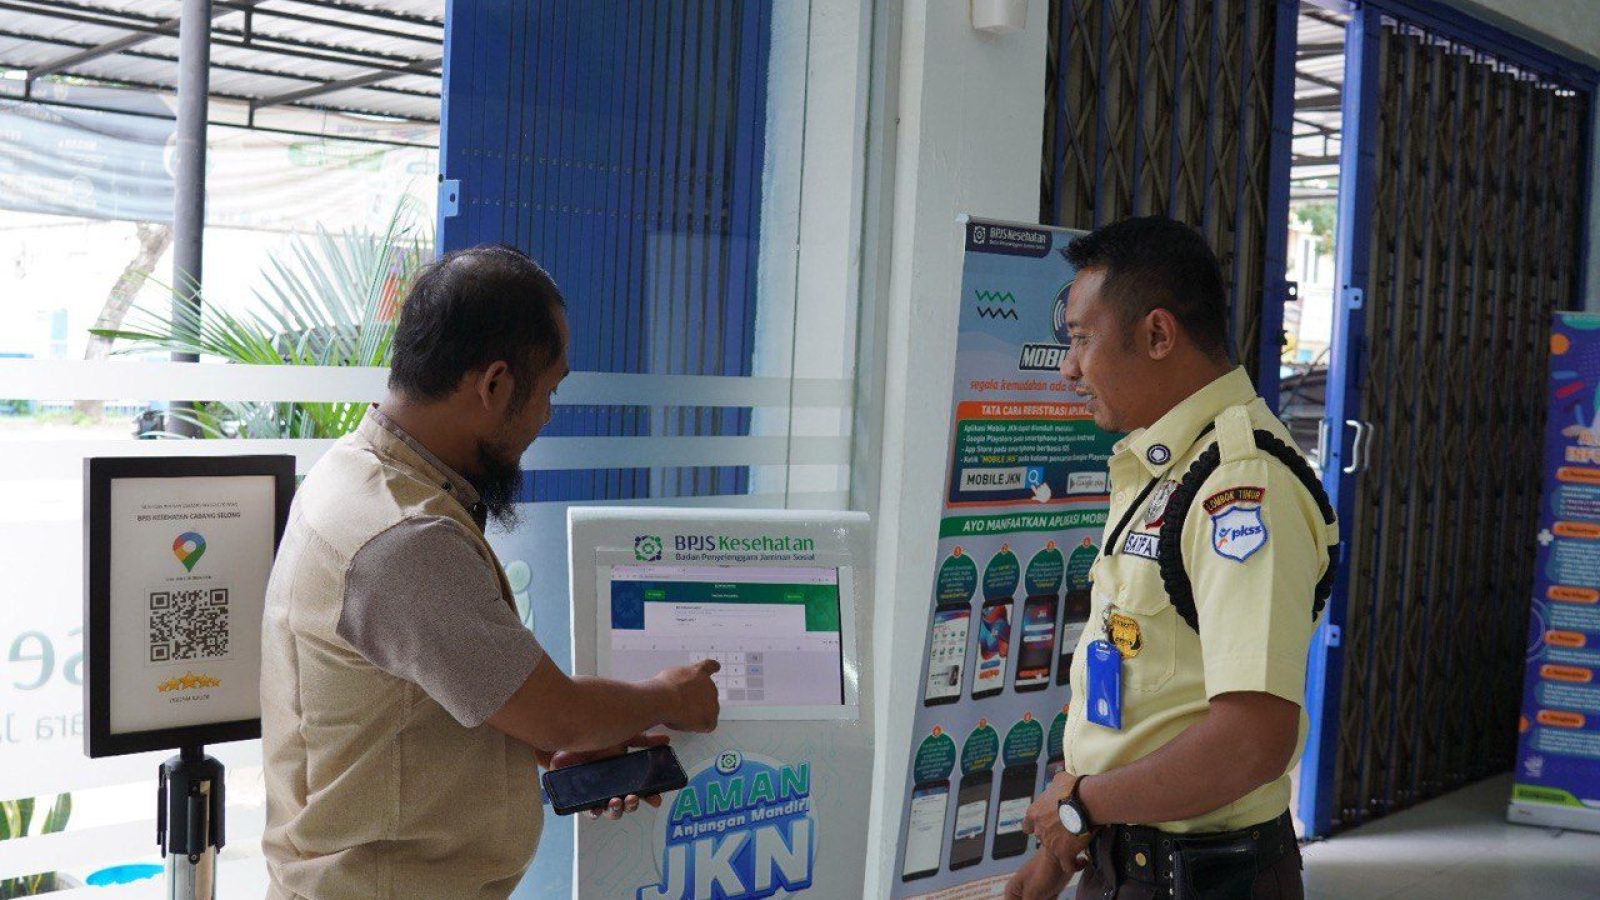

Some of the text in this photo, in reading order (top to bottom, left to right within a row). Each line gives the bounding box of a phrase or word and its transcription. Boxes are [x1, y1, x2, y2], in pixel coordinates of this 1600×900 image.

[990, 227, 1046, 244] BPJS Kesehatan
[1021, 347, 1067, 368] MOBI
[981, 405, 1000, 416] TATA
[1002, 405, 1022, 416] CARA
[1023, 405, 1068, 416] REGISTRASI
[966, 473, 1021, 485] MOBILE JKN
[962, 520, 985, 532] AYO
[986, 517, 1047, 531] MANFAATKAN
[1048, 513, 1080, 527] APLIKASI
[1231, 524, 1263, 541] pkss
[674, 534, 816, 551] BPJS Kesehatan
[675, 553, 816, 562] Badan Penyelenggara Jaminan Sosial
[672, 762, 810, 822] AMAN
[672, 799, 810, 839] Anjungan Mandiri
[640, 817, 812, 900] JKN
